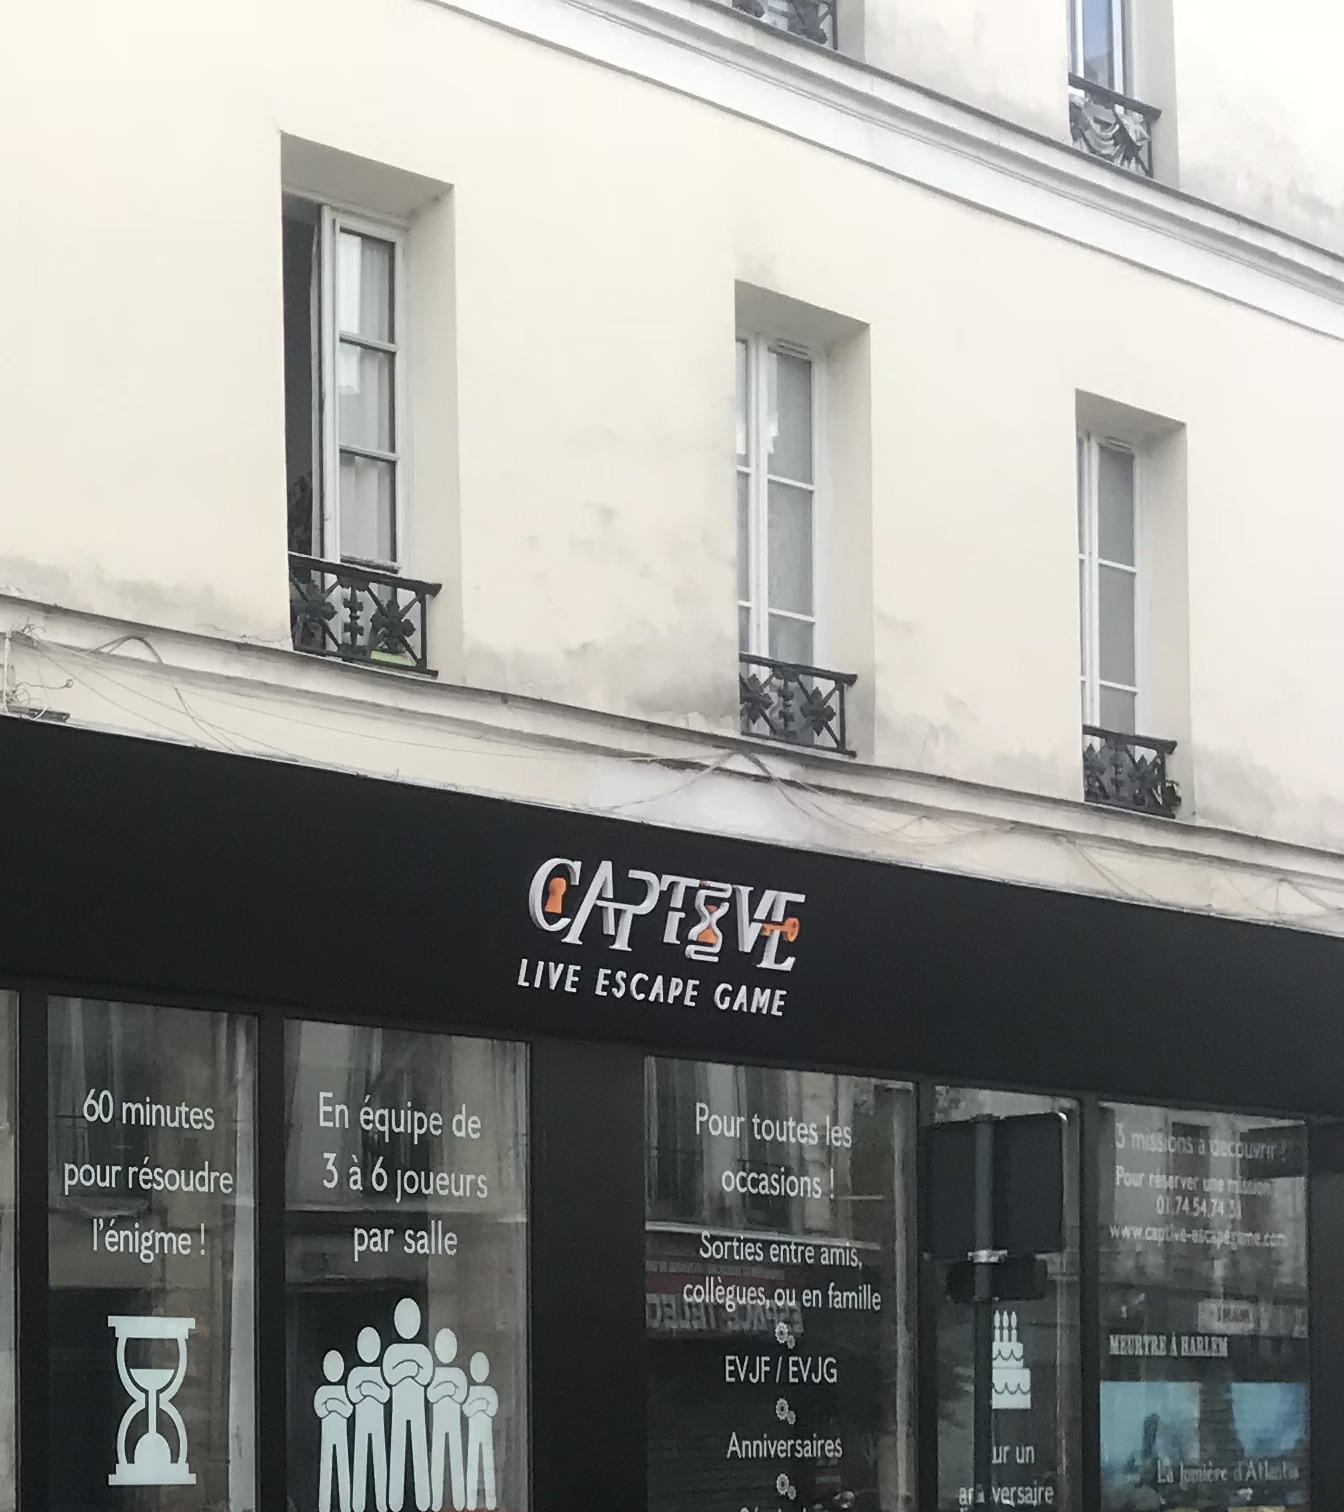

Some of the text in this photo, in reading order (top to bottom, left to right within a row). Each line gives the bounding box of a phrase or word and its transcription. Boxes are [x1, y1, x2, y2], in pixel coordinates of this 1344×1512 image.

[517, 958, 788, 1016] LIVE ESCAPE GAME
[83, 1090, 216, 1131] 60 minutes
[319, 1091, 482, 1144] En équipe de
[695, 1101, 852, 1149] Pour toutes les
[1115, 1122, 1125, 1149] 3
[1131, 1132, 1194, 1154] missions
[64, 1158, 234, 1195] pour résoudre
[323, 1152, 488, 1203] 3 à 6 joueurs
[722, 1166, 835, 1200] occasions !
[93, 1222, 207, 1263] l'énigme !
[354, 1219, 458, 1261] par salle
[699, 1230, 862, 1270] Sorties entre amis,
[683, 1276, 882, 1313] collègues, ou en famille
[1109, 1334, 1167, 1356] MEURTRE
[1181, 1336, 1228, 1357] HARLEM
[725, 1355, 838, 1384] EVJF / EVJG
[727, 1432, 842, 1460] Anniversaires
[1016, 1445, 1035, 1464] un
